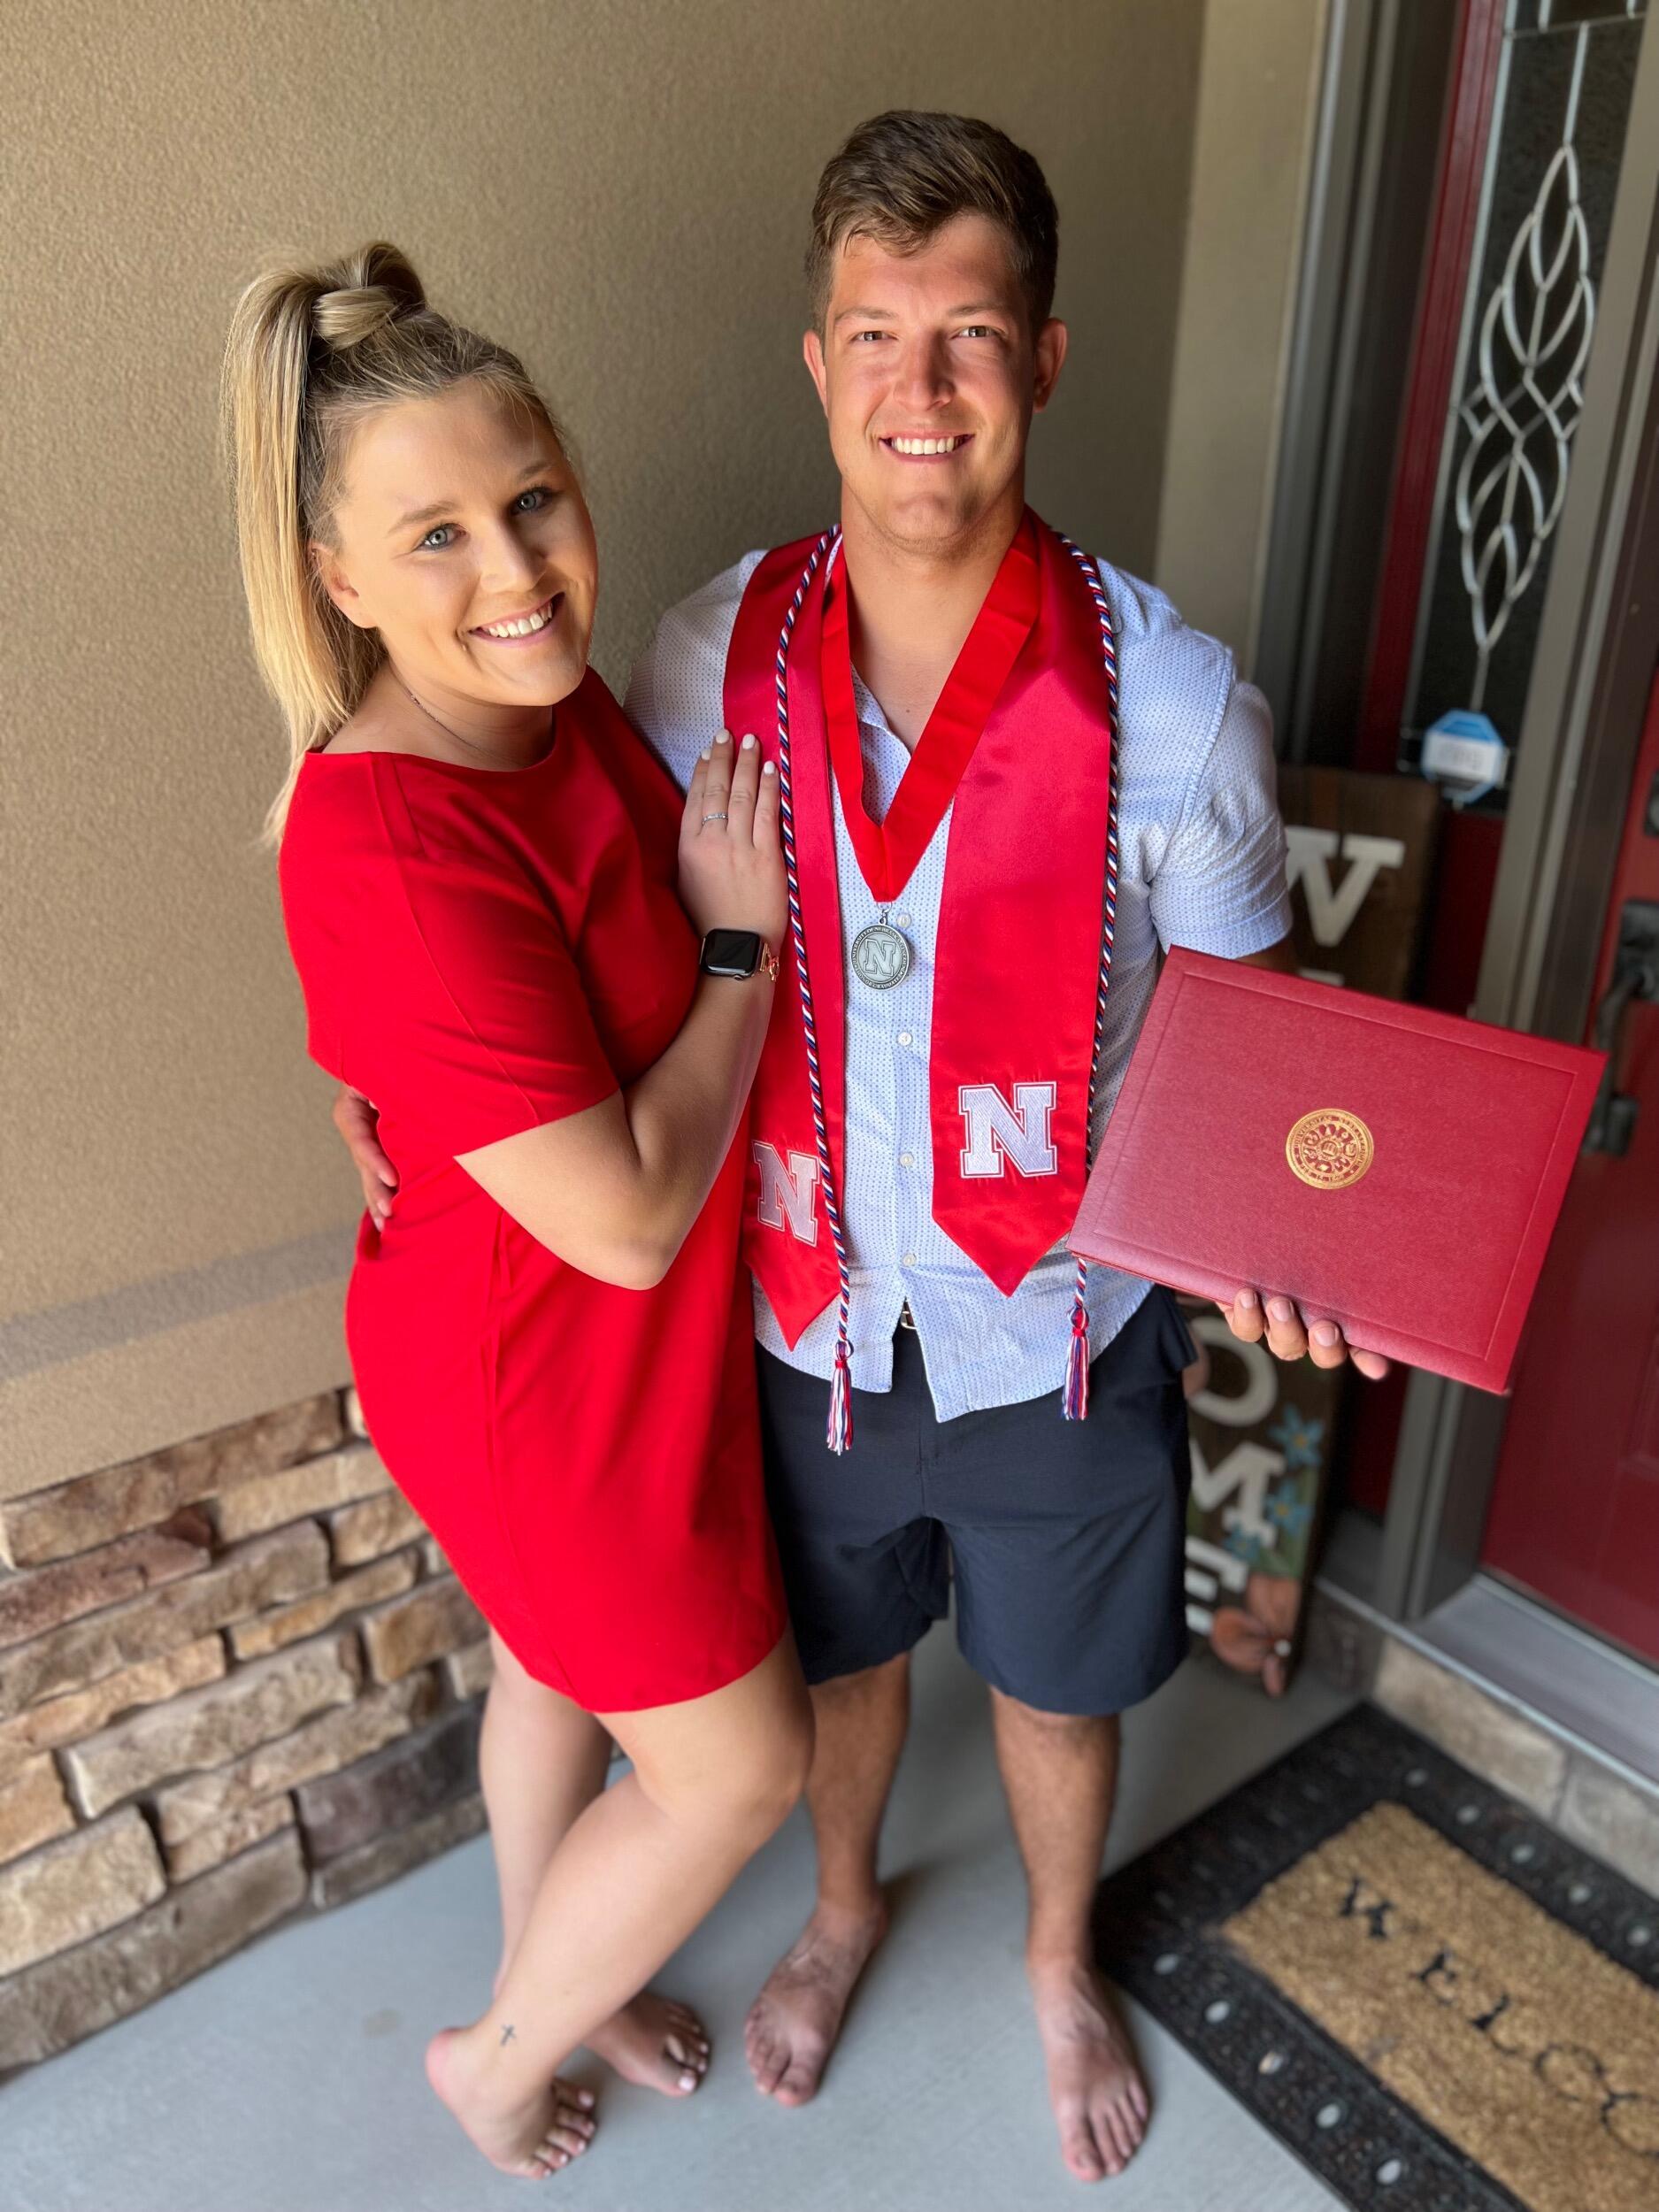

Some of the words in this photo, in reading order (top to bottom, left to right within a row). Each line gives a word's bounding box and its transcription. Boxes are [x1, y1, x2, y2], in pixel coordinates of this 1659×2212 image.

[852, 931, 867, 963] UNIVERSITY
[864, 938, 895, 977] N
[958, 1081, 1057, 1179] N
[751, 1140, 820, 1248] N
